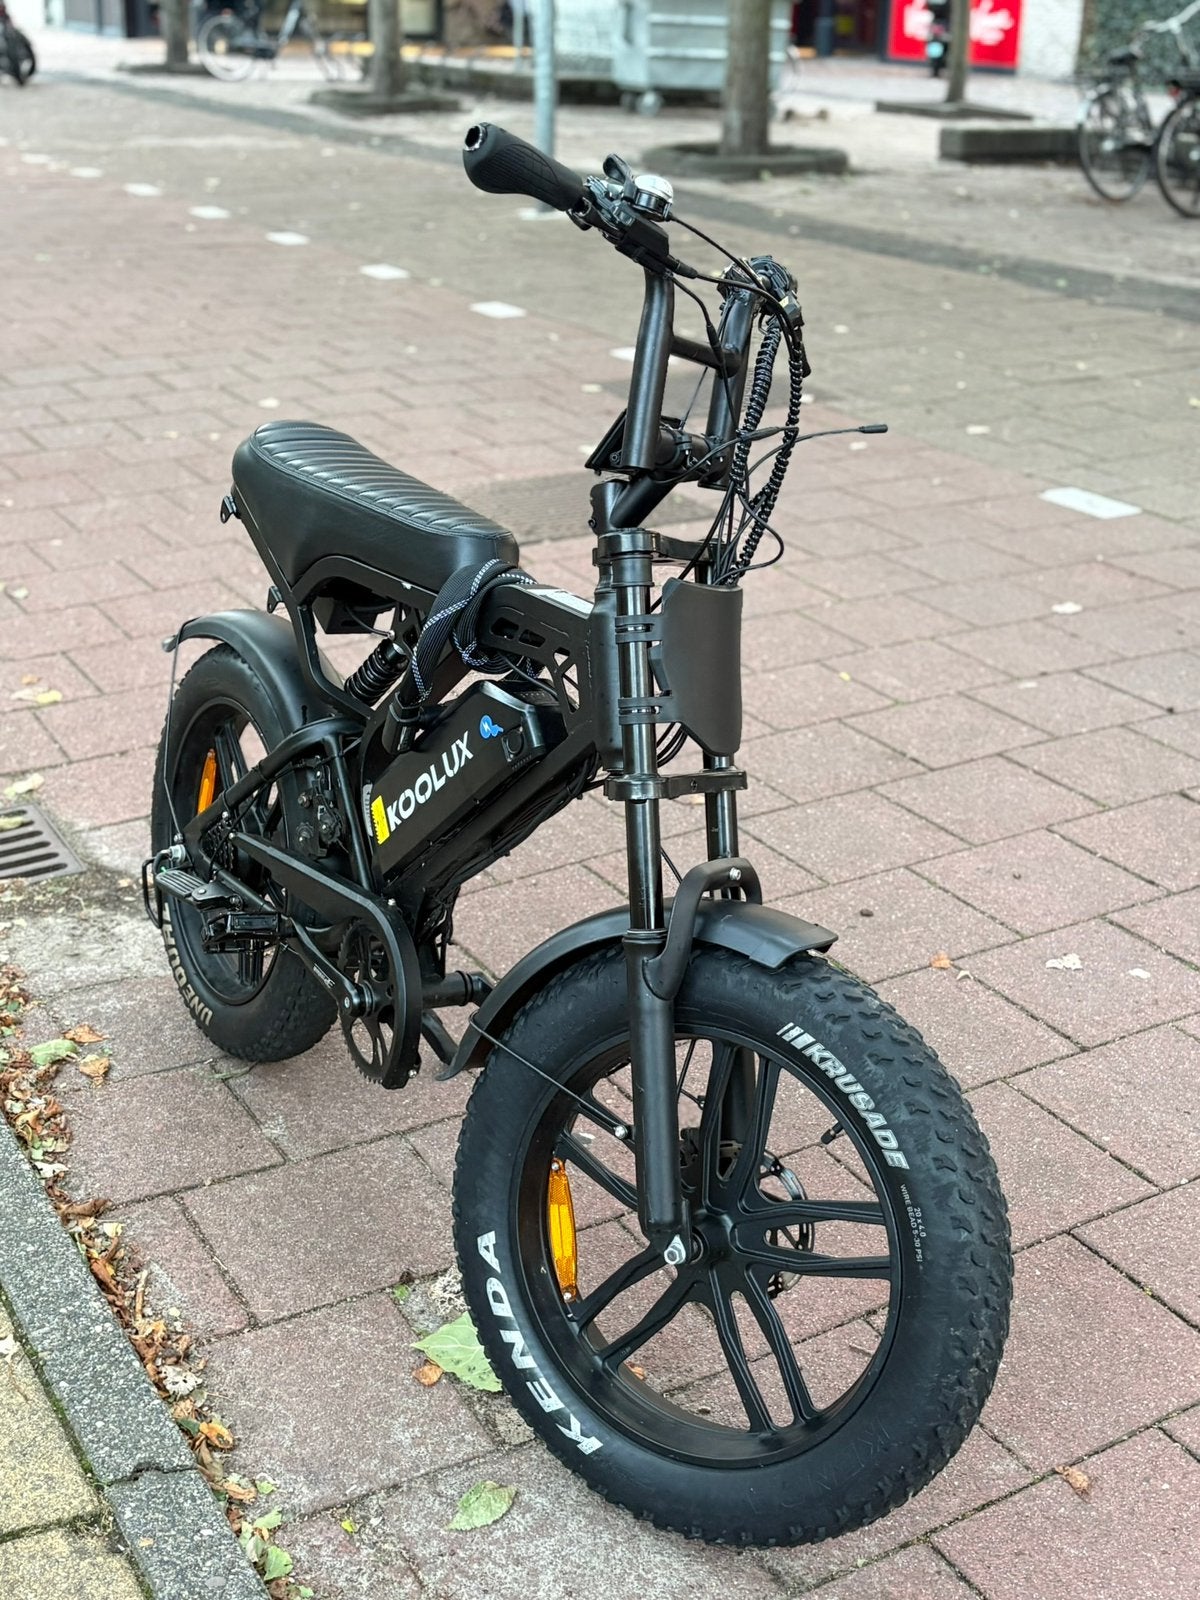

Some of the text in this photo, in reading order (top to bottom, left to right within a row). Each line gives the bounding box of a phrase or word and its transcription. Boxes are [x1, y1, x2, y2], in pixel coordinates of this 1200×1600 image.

[386, 730, 474, 832] KOOLUX
[801, 1042, 910, 1170] KRUSADE
[900, 1183, 923, 1262] WIRE BEAD 5-30 PSI
[913, 1207, 922, 1217] 20
[919, 1225, 927, 1238] 4.0
[477, 1230, 604, 1455] KENDA
